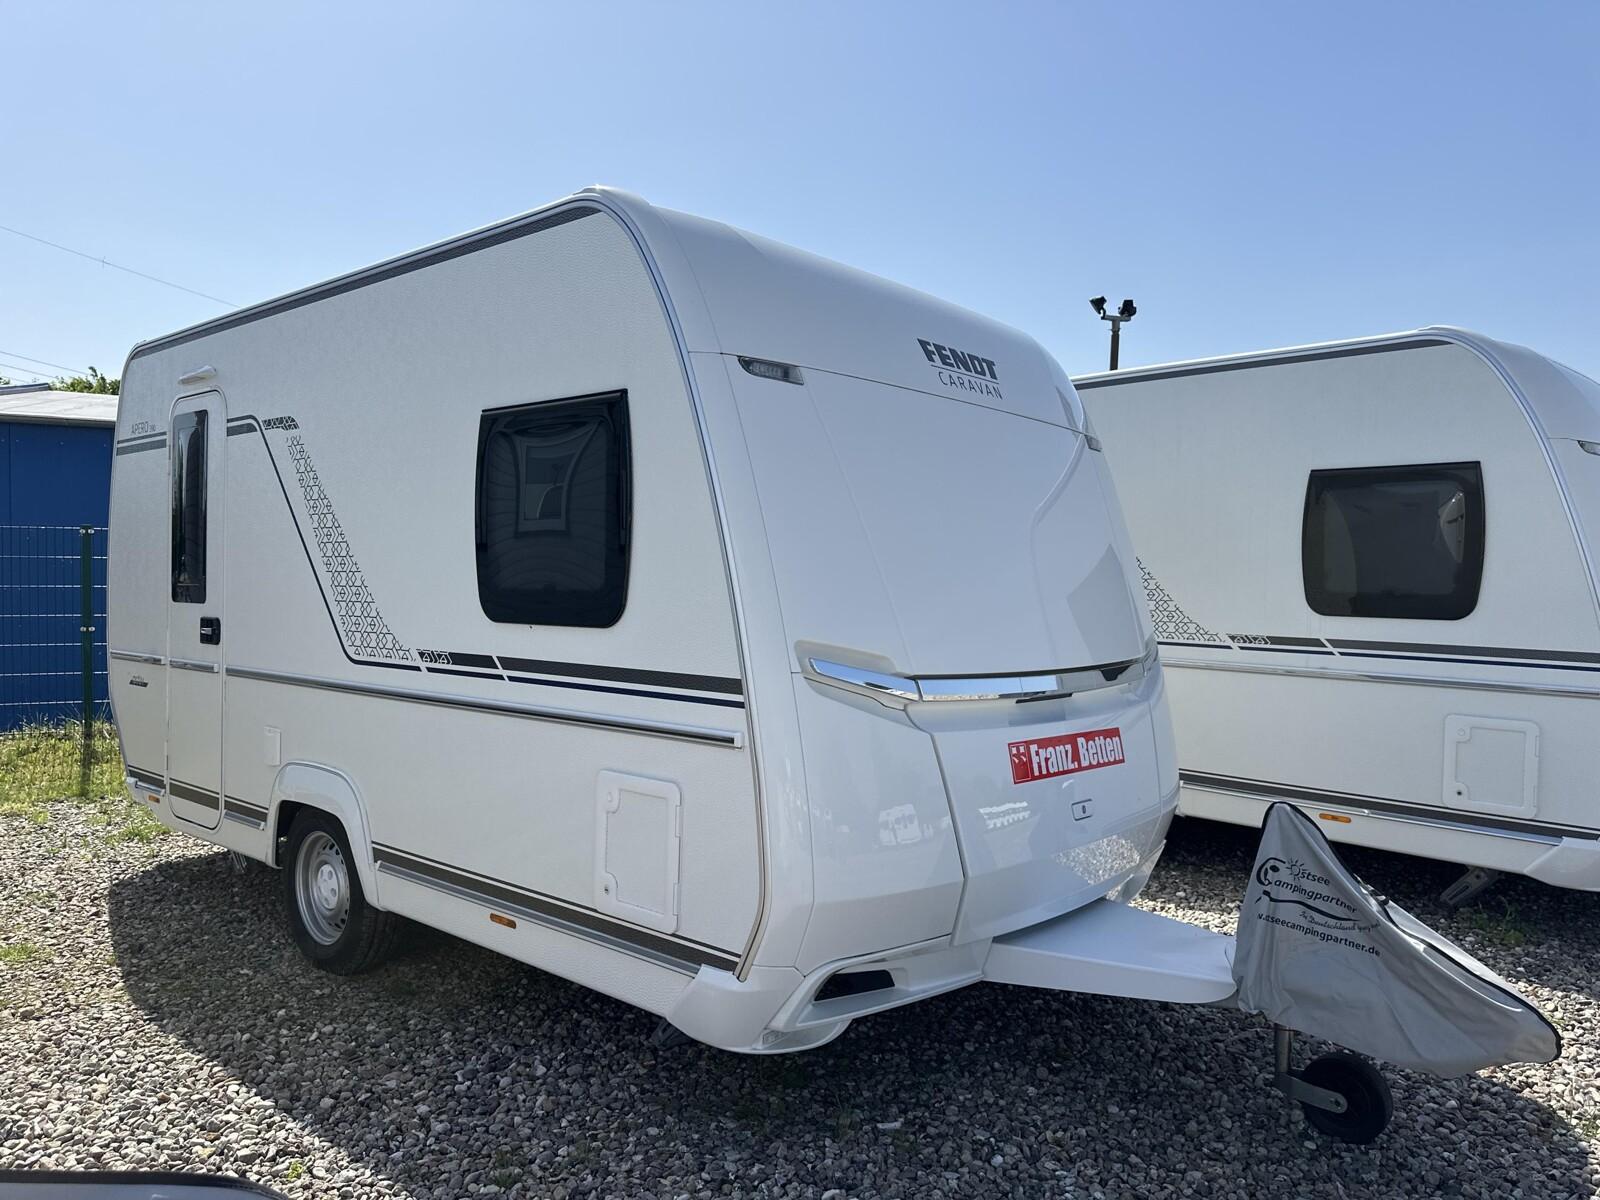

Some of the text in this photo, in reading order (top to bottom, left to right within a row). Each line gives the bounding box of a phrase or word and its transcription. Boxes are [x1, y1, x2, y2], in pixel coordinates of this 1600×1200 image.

[917, 338, 998, 380] FENDT
[938, 371, 1003, 400] CARAVAN
[1029, 736, 1123, 776] Franz. Betten
